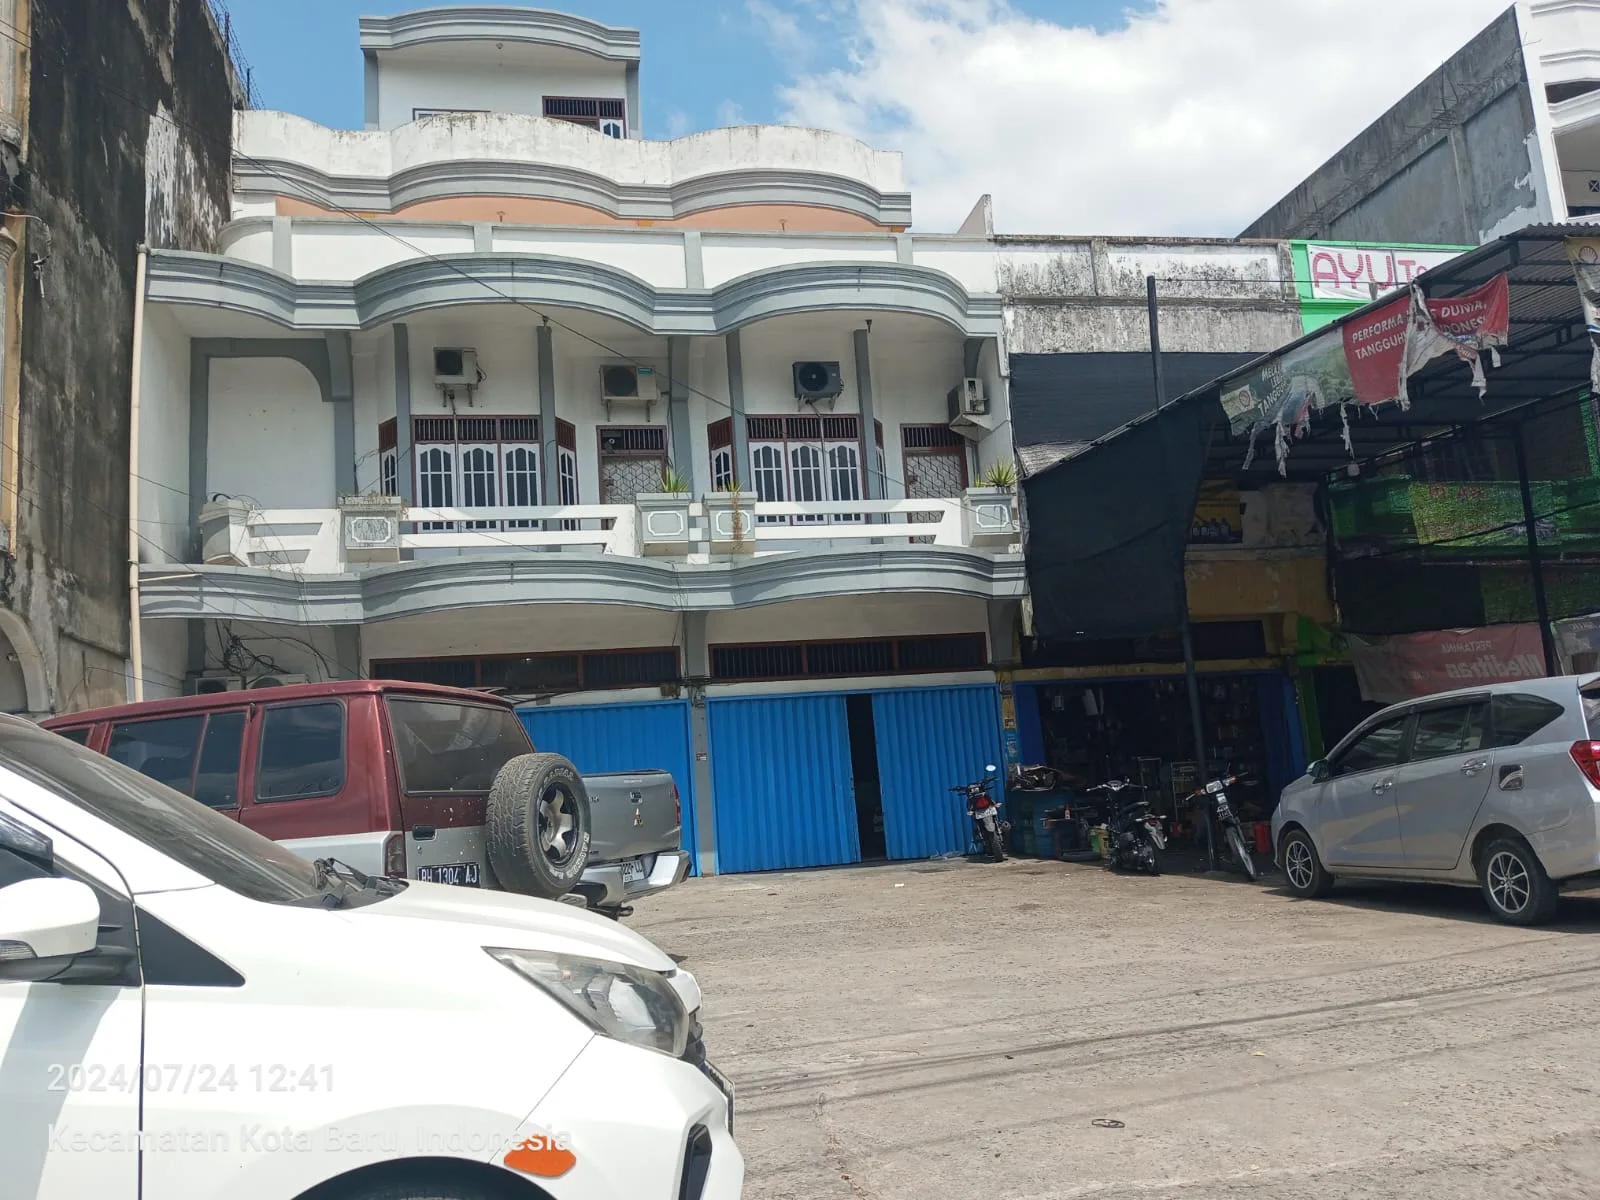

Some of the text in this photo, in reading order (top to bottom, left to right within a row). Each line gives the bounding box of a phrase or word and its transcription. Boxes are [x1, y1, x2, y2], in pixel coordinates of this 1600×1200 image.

[1312, 252, 1393, 291] AYU
[1352, 315, 1403, 344] PERFORMA
[1354, 332, 1406, 361] TANGGUH
[436, 867, 459, 885] 1304
[465, 865, 477, 884] AJ
